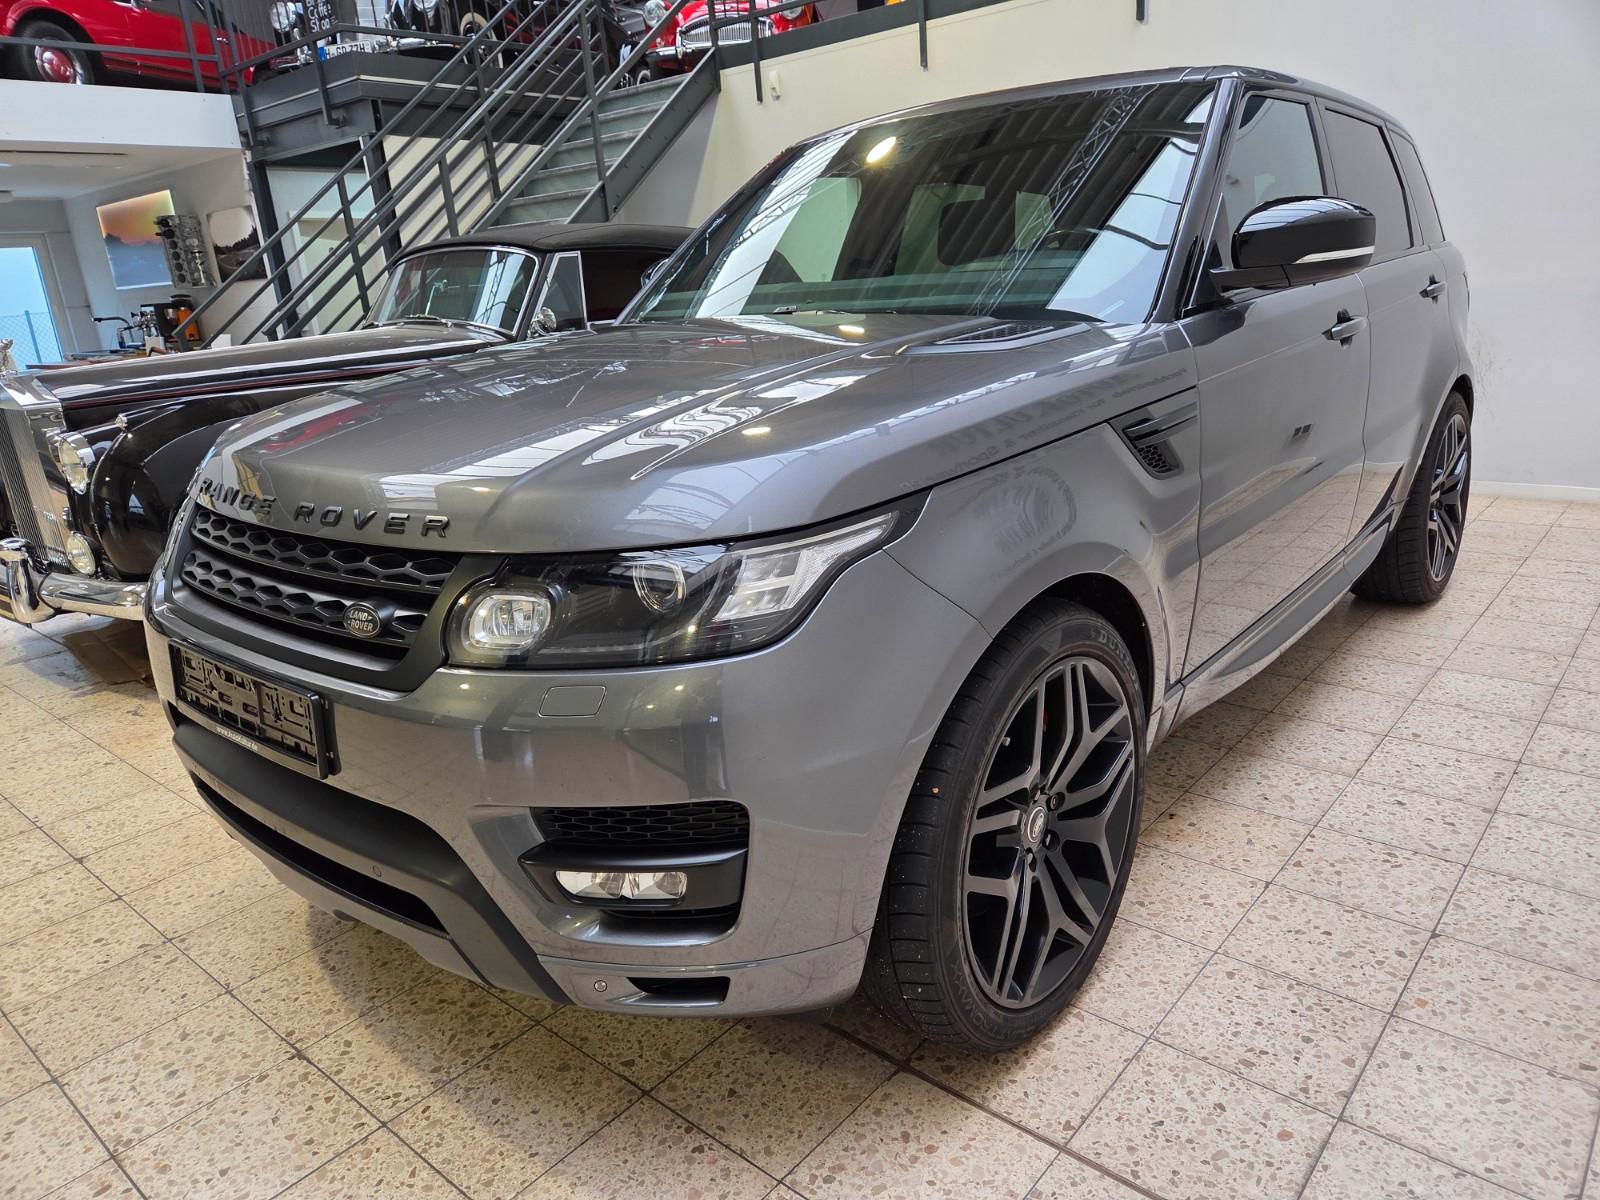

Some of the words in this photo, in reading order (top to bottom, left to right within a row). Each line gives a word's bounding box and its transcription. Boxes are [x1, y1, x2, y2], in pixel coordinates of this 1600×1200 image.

[199, 477, 276, 516] RANGE
[294, 502, 450, 538] ROVER
[349, 610, 368, 621] LAND
[350, 619, 373, 632] ROVER
